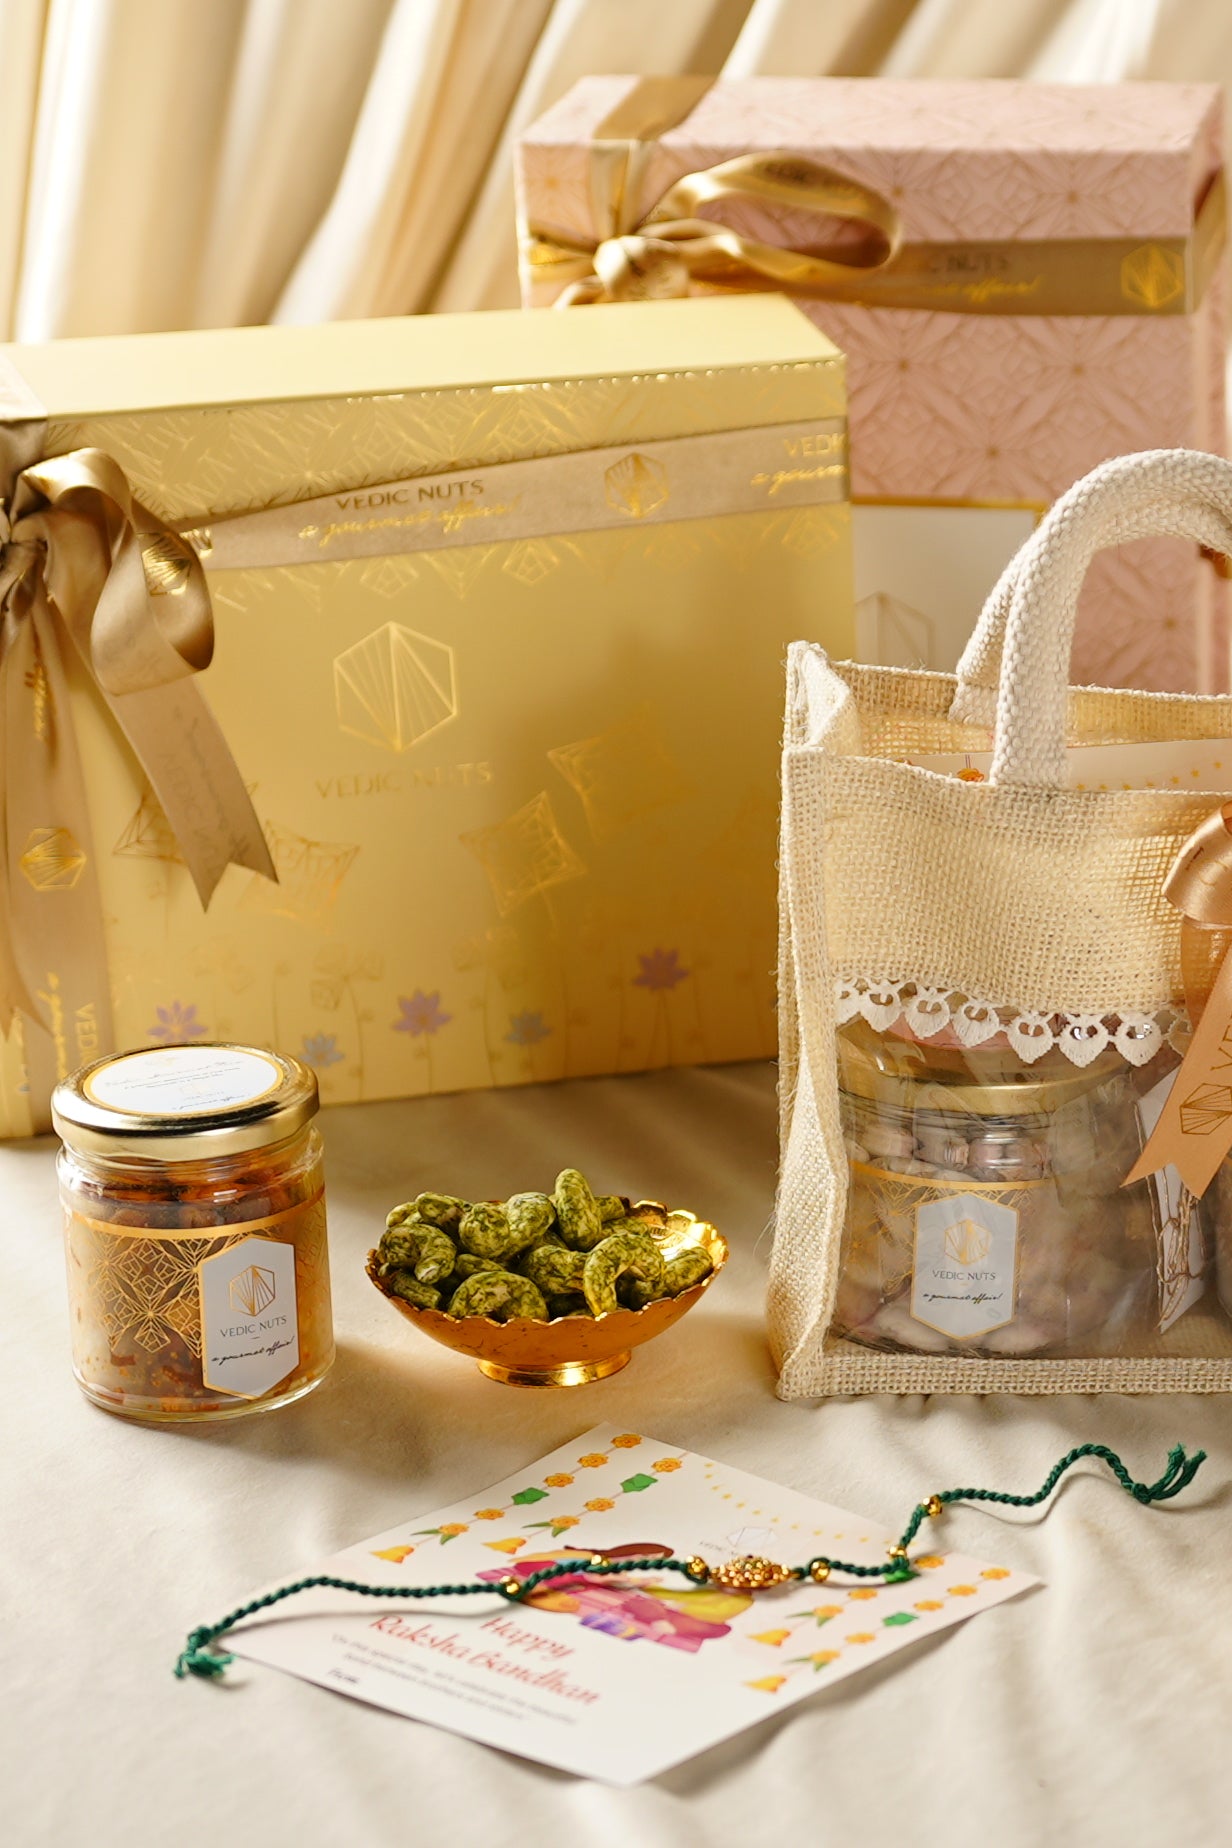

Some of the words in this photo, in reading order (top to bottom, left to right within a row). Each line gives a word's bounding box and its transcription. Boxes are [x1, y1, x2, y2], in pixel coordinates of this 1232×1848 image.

[335, 488, 409, 510] VEDIC
[418, 479, 484, 501] NUTS
[932, 1270, 964, 1281] VEDIC
[967, 1272, 996, 1281] NUTS
[220, 1324, 256, 1337] VEDIC
[260, 1315, 287, 1330] NUTS
[480, 1615, 576, 1661] Happy
[369, 1614, 471, 1660] Raksha
[467, 1651, 602, 1706] Bandhan
